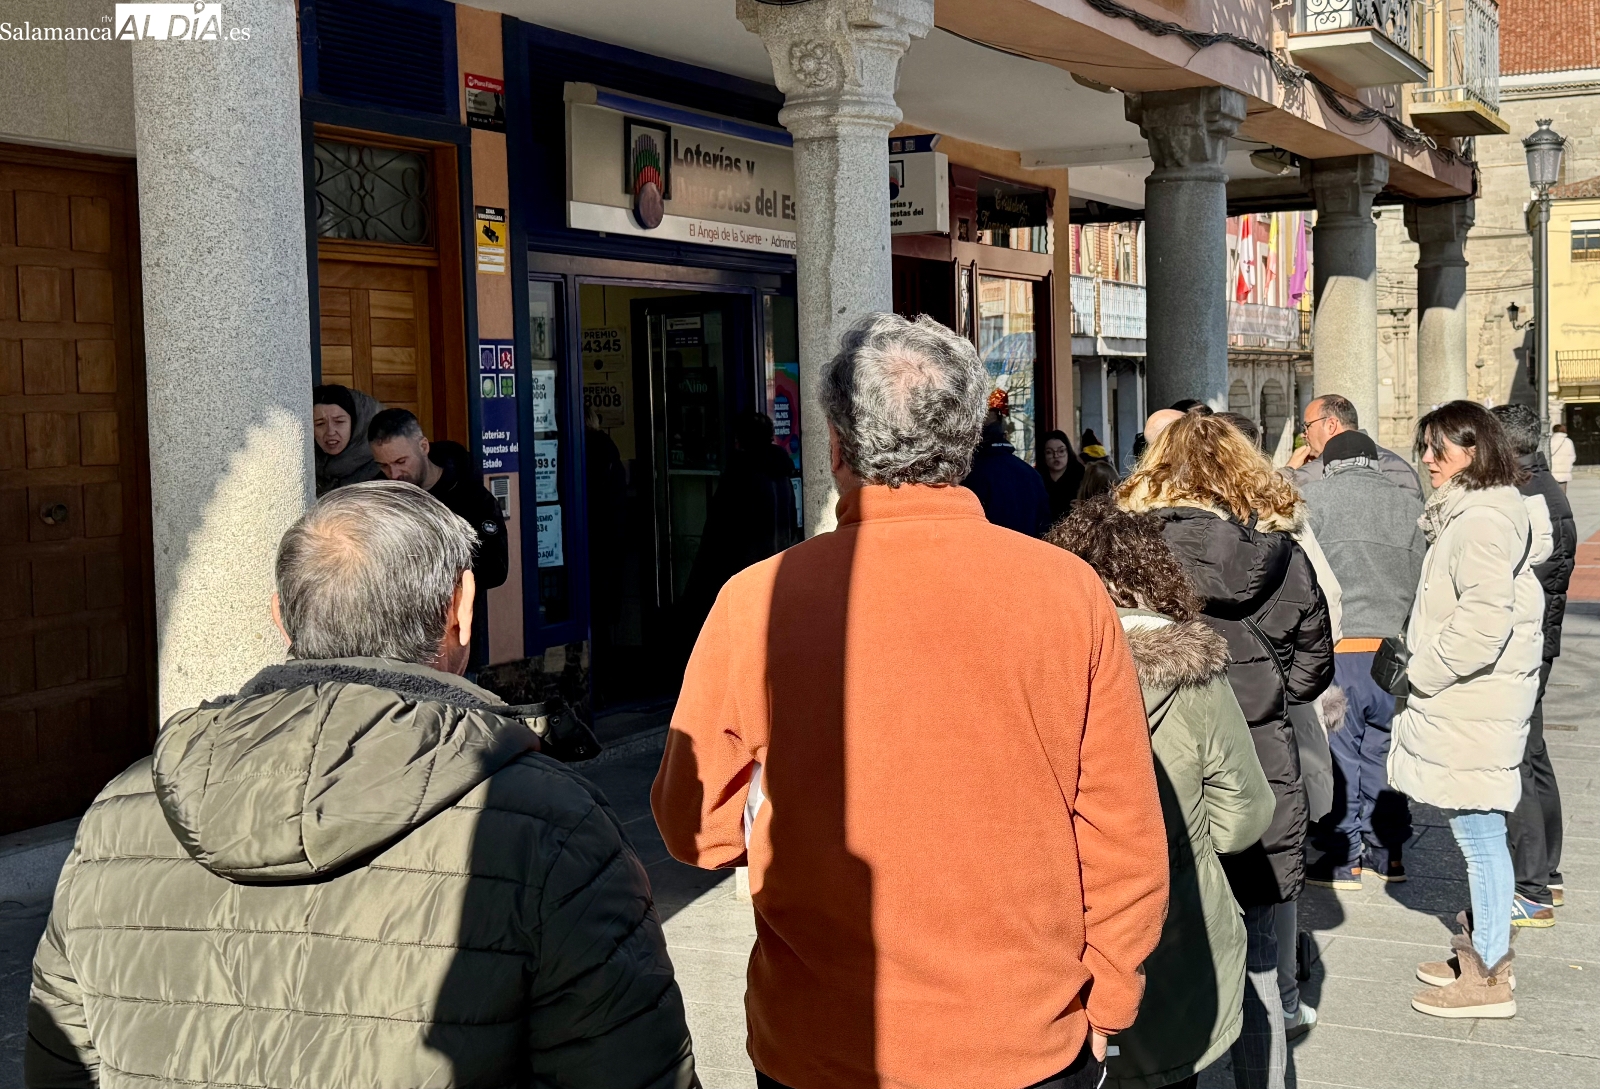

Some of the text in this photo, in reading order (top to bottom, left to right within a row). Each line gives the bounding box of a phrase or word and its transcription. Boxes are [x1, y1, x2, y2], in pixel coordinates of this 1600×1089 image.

[673, 138, 756, 178] Loterías y
[755, 187, 778, 218] del
[908, 201, 913, 209] y
[912, 208, 924, 217] del
[690, 223, 696, 237] El
[698, 221, 720, 243] Ángel
[721, 228, 731, 242] de
[732, 228, 739, 243] la
[740, 230, 762, 246] Suerte
[584, 330, 618, 340] PREMIO
[582, 339, 622, 353] 4345
[583, 386, 617, 396] PREMIO
[506, 431, 511, 442] y
[482, 442, 519, 457] Apuestas del
[482, 457, 503, 469] Estado
